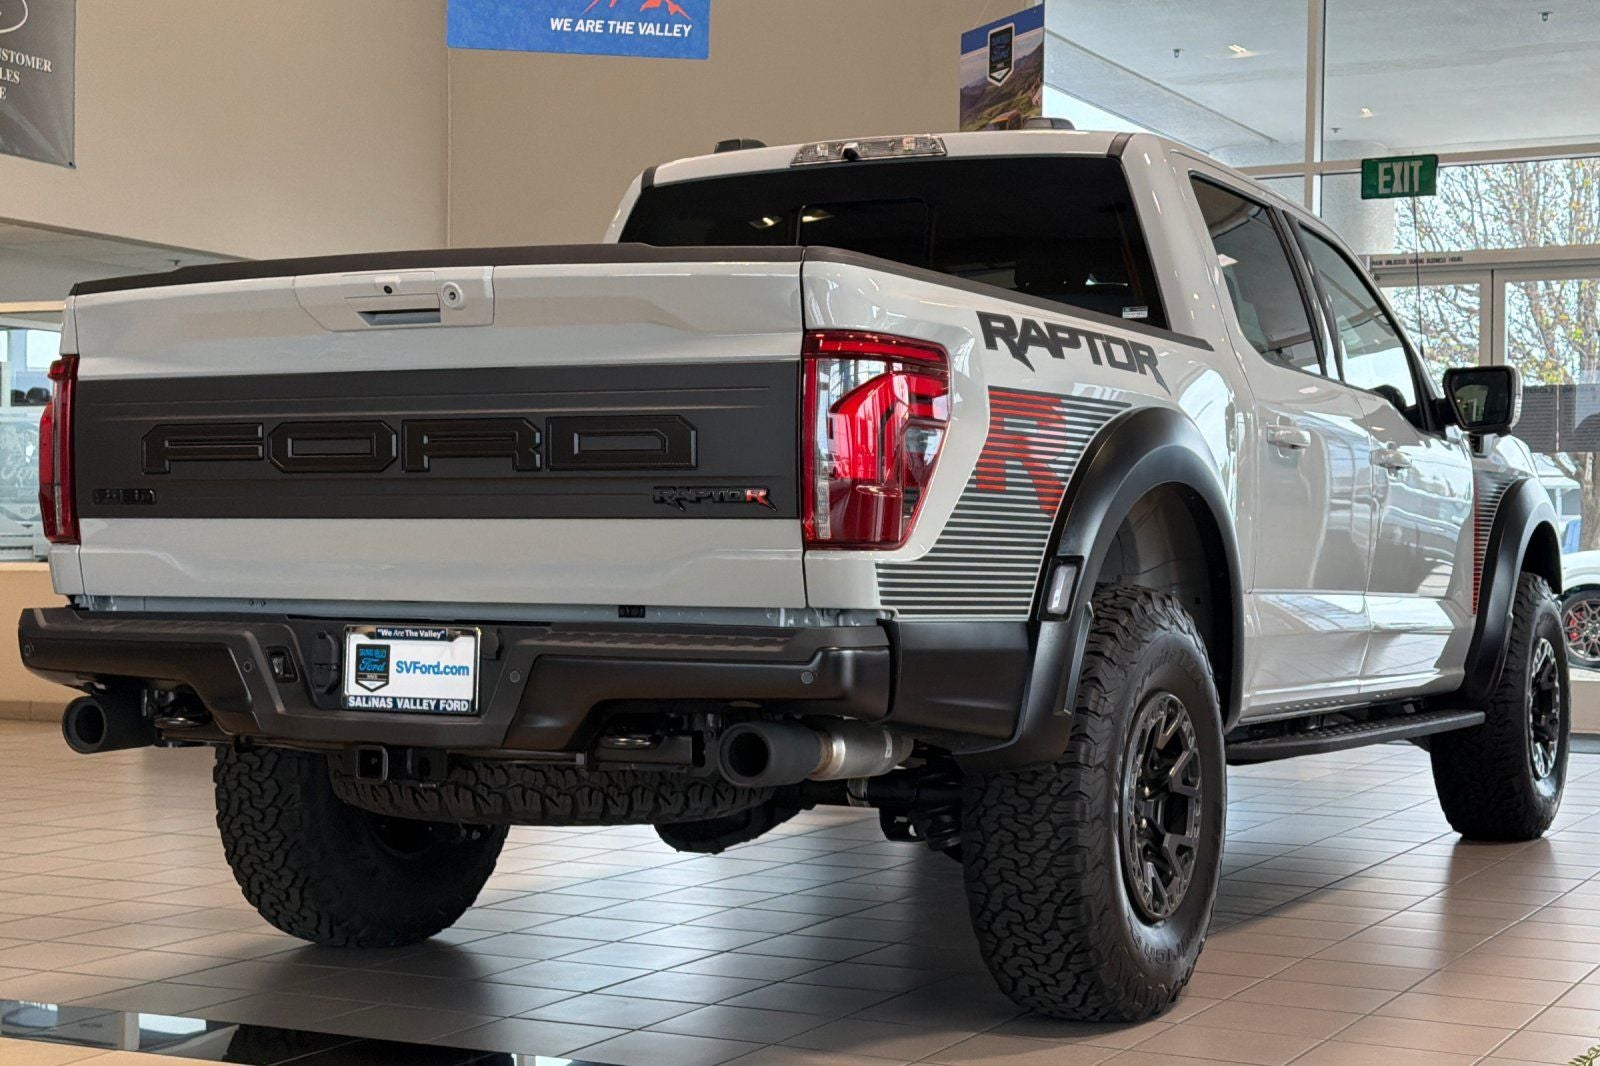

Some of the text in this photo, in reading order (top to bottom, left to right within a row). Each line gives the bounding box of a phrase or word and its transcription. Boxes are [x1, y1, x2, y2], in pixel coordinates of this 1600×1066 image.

[549, 17, 692, 37] WE ARE THE VALLEY
[1378, 161, 1423, 194] EXIT
[976, 311, 1172, 396] RAPTOR
[140, 414, 698, 475] FORD
[653, 485, 778, 513] RAPTOR
[393, 629, 404, 637] Are
[404, 629, 419, 637] The
[359, 657, 387, 672] Ford
[395, 660, 470, 677] SVFord.com
[348, 696, 469, 712] SALINAS VALLEY FORD
